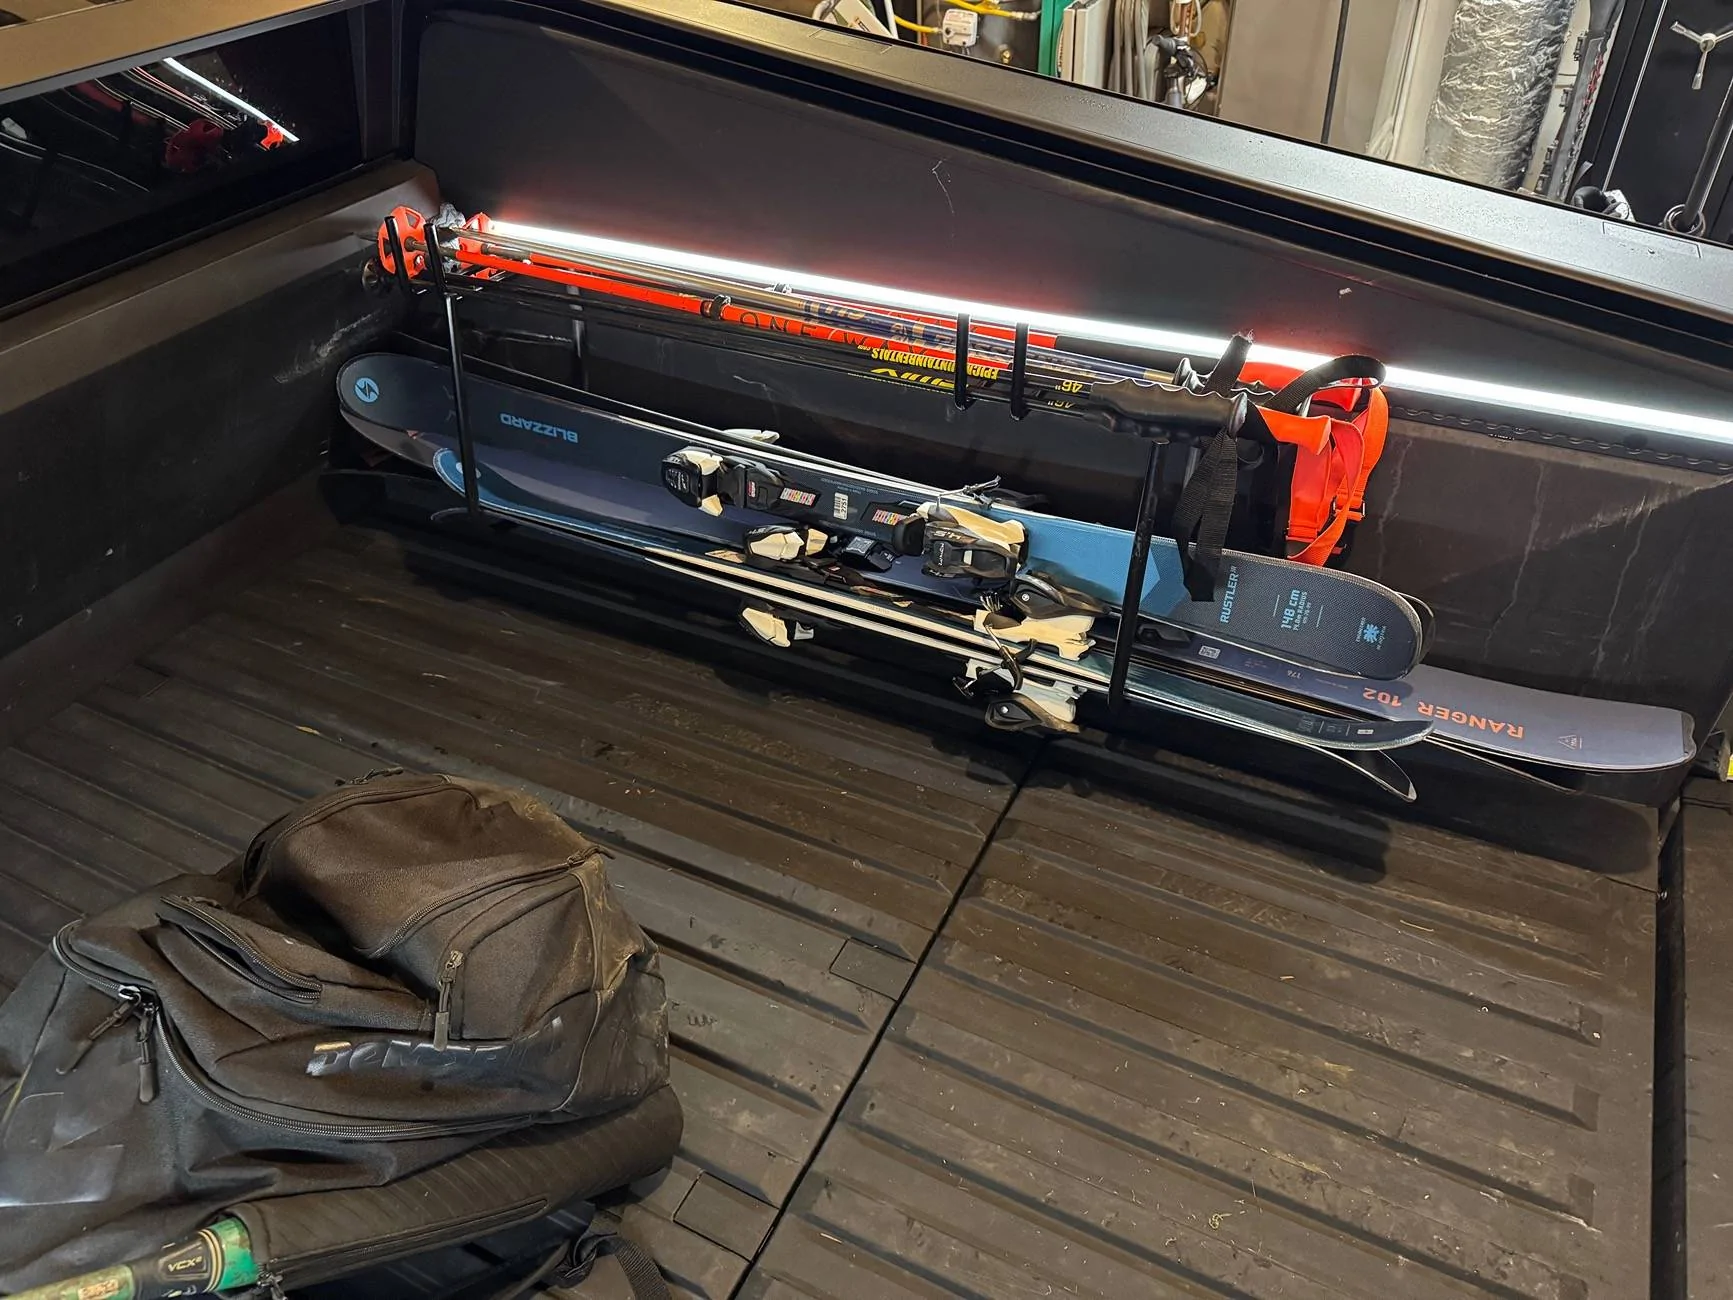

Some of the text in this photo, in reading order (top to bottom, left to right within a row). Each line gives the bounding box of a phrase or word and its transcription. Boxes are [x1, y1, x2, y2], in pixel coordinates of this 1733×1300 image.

[499, 412, 579, 444] BLIZZARD
[1219, 573, 1240, 624] RUSTLER
[1280, 589, 1302, 630] 148 cm
[1362, 687, 1526, 740] RANGER 102
